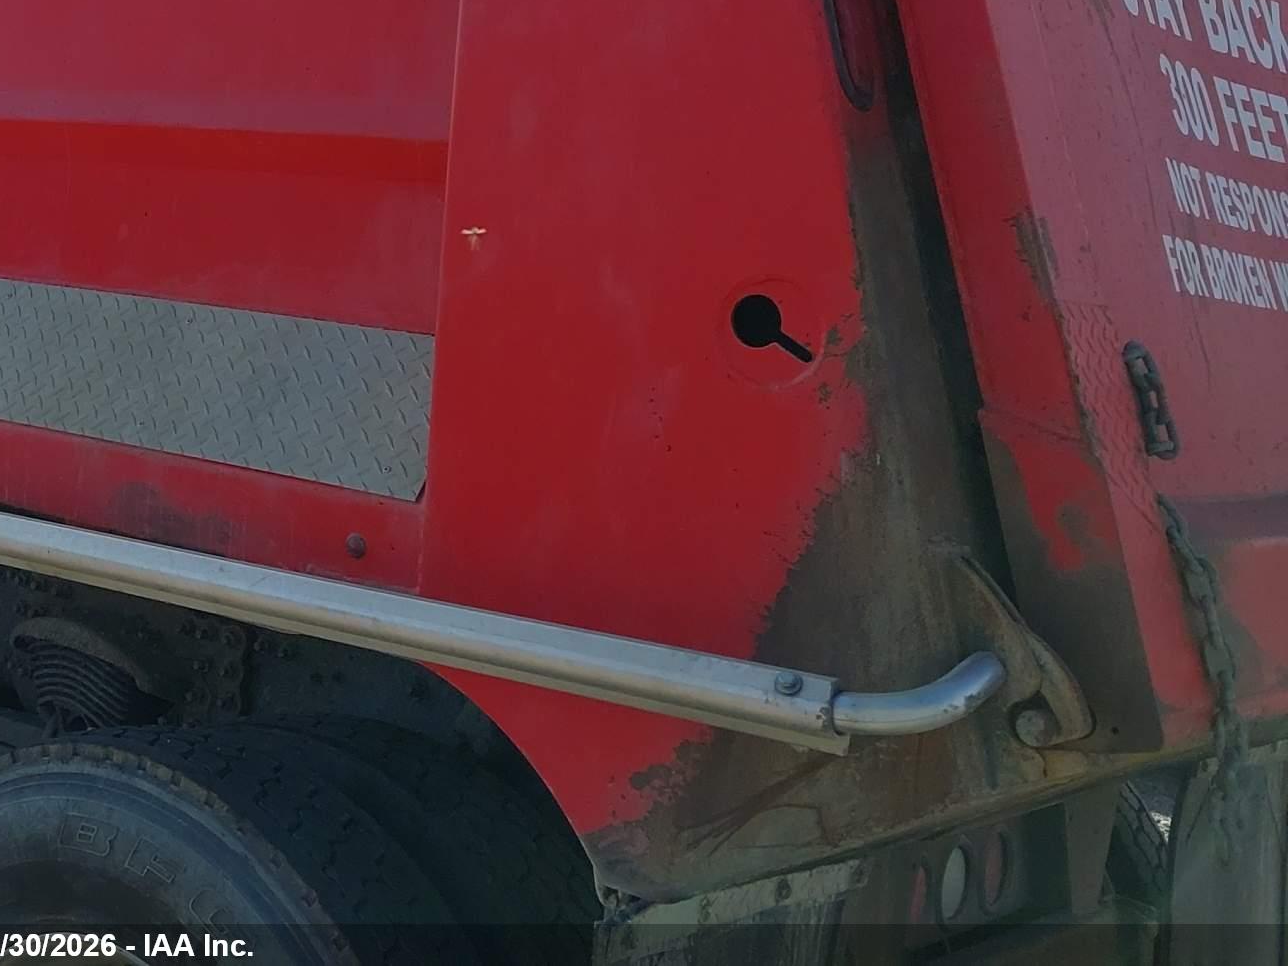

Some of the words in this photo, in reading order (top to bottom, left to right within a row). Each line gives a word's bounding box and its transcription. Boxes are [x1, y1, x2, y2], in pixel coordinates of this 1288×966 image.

[1159, 53, 1220, 147] 300
[1165, 157, 1210, 220] NOT
[1162, 234, 1209, 298] FOR
[1200, 244, 1277, 310] BROKEN
